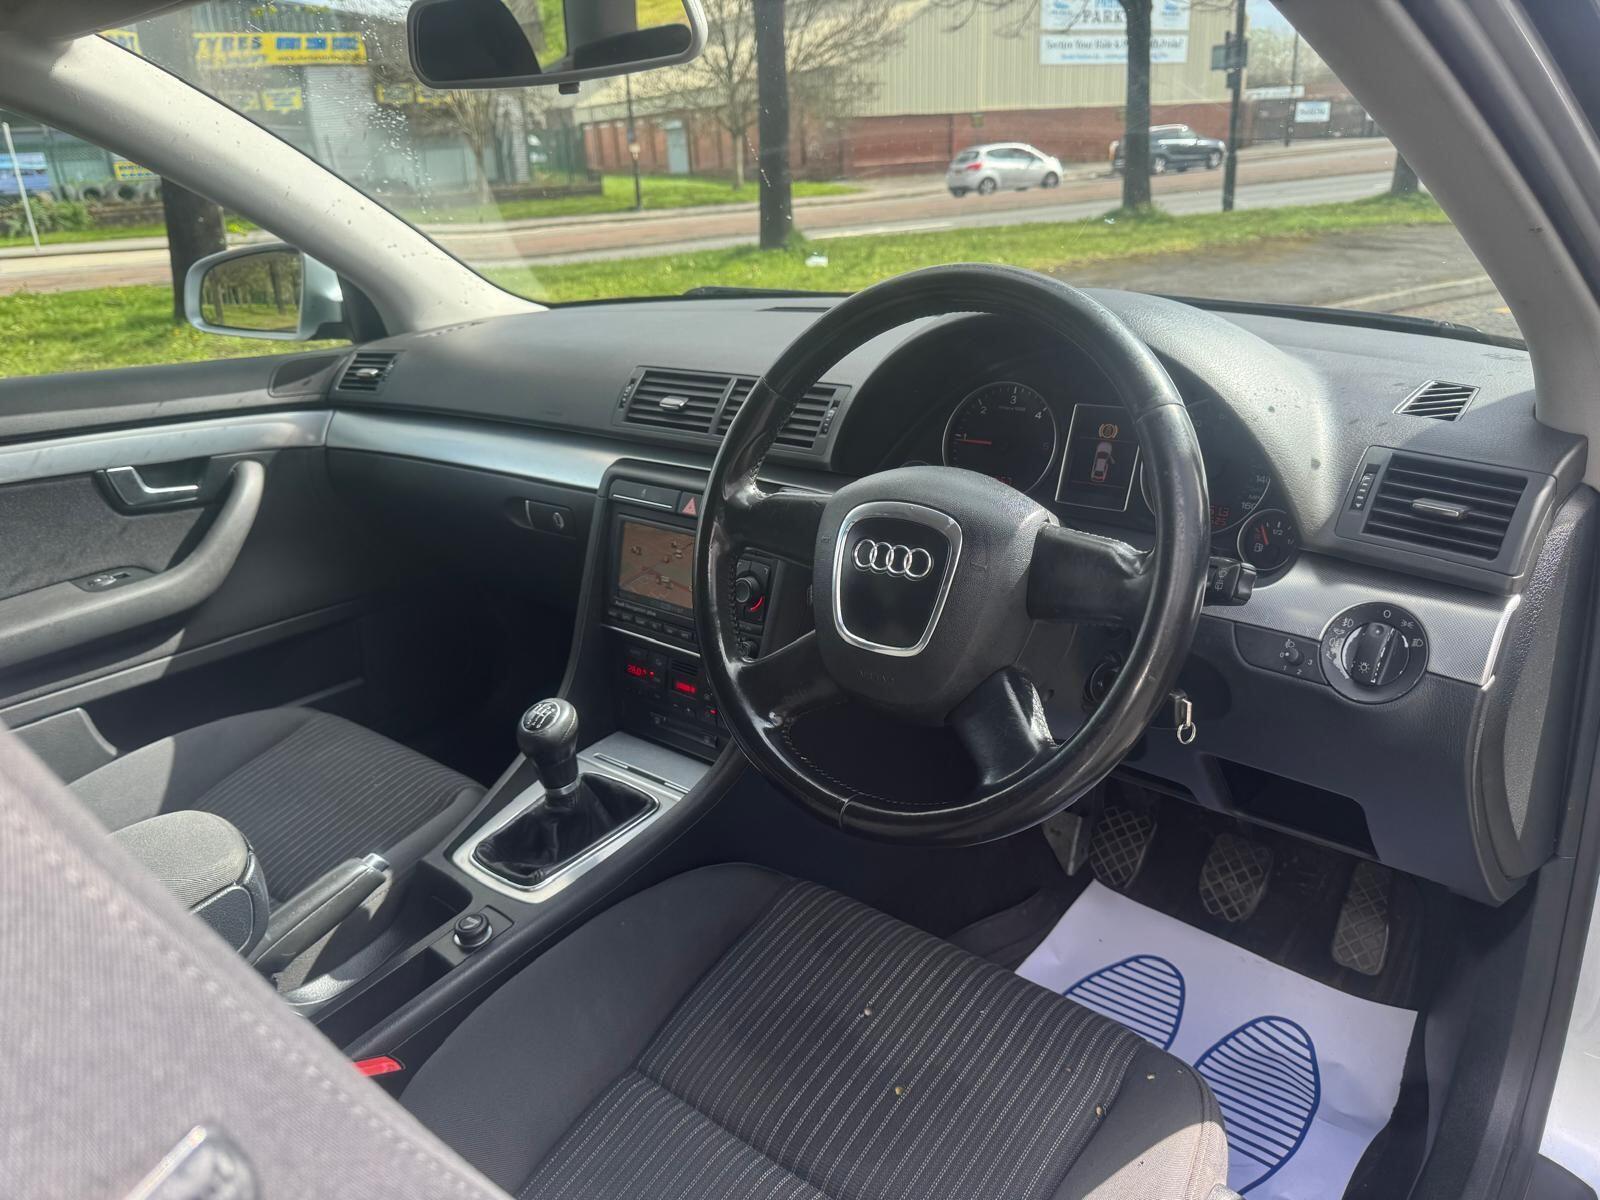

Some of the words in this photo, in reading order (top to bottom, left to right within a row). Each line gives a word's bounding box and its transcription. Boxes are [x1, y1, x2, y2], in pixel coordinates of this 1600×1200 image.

[192, 36, 263, 50] TYRES
[1010, 395, 1017, 405] 3
[980, 406, 988, 415] 2
[1034, 411, 1042, 420] 4
